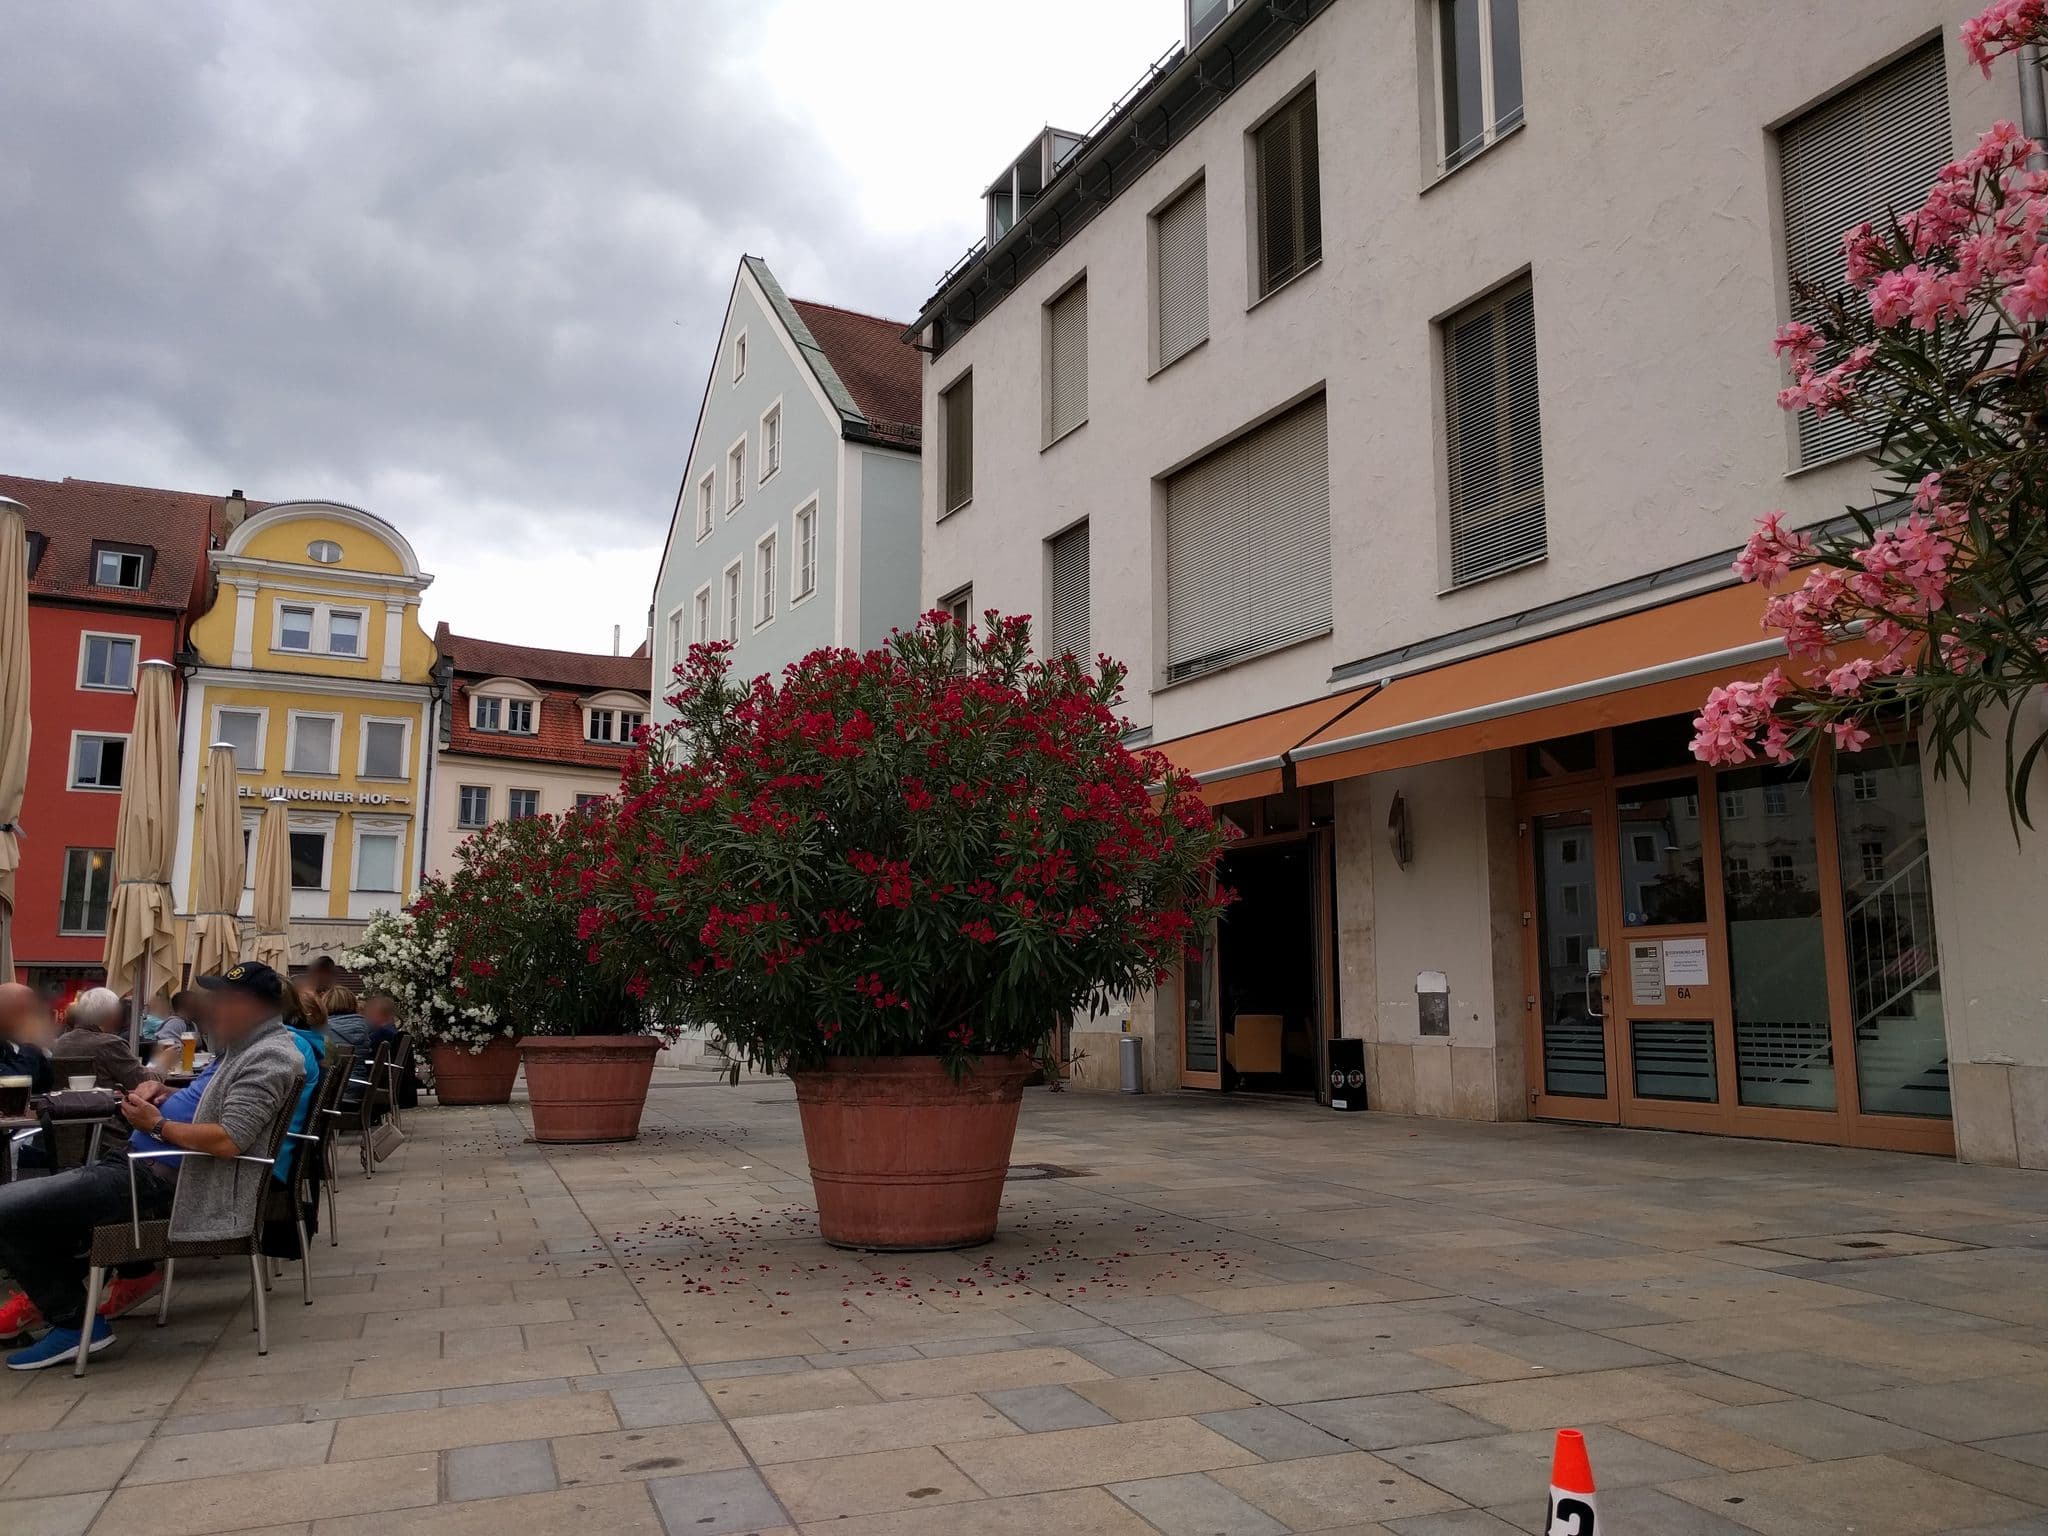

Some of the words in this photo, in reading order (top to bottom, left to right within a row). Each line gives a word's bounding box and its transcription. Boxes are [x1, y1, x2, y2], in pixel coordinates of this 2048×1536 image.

[261, 784, 354, 803] MÜNCHNER
[359, 792, 391, 805] HOF
[1677, 987, 1691, 1000] 6A
